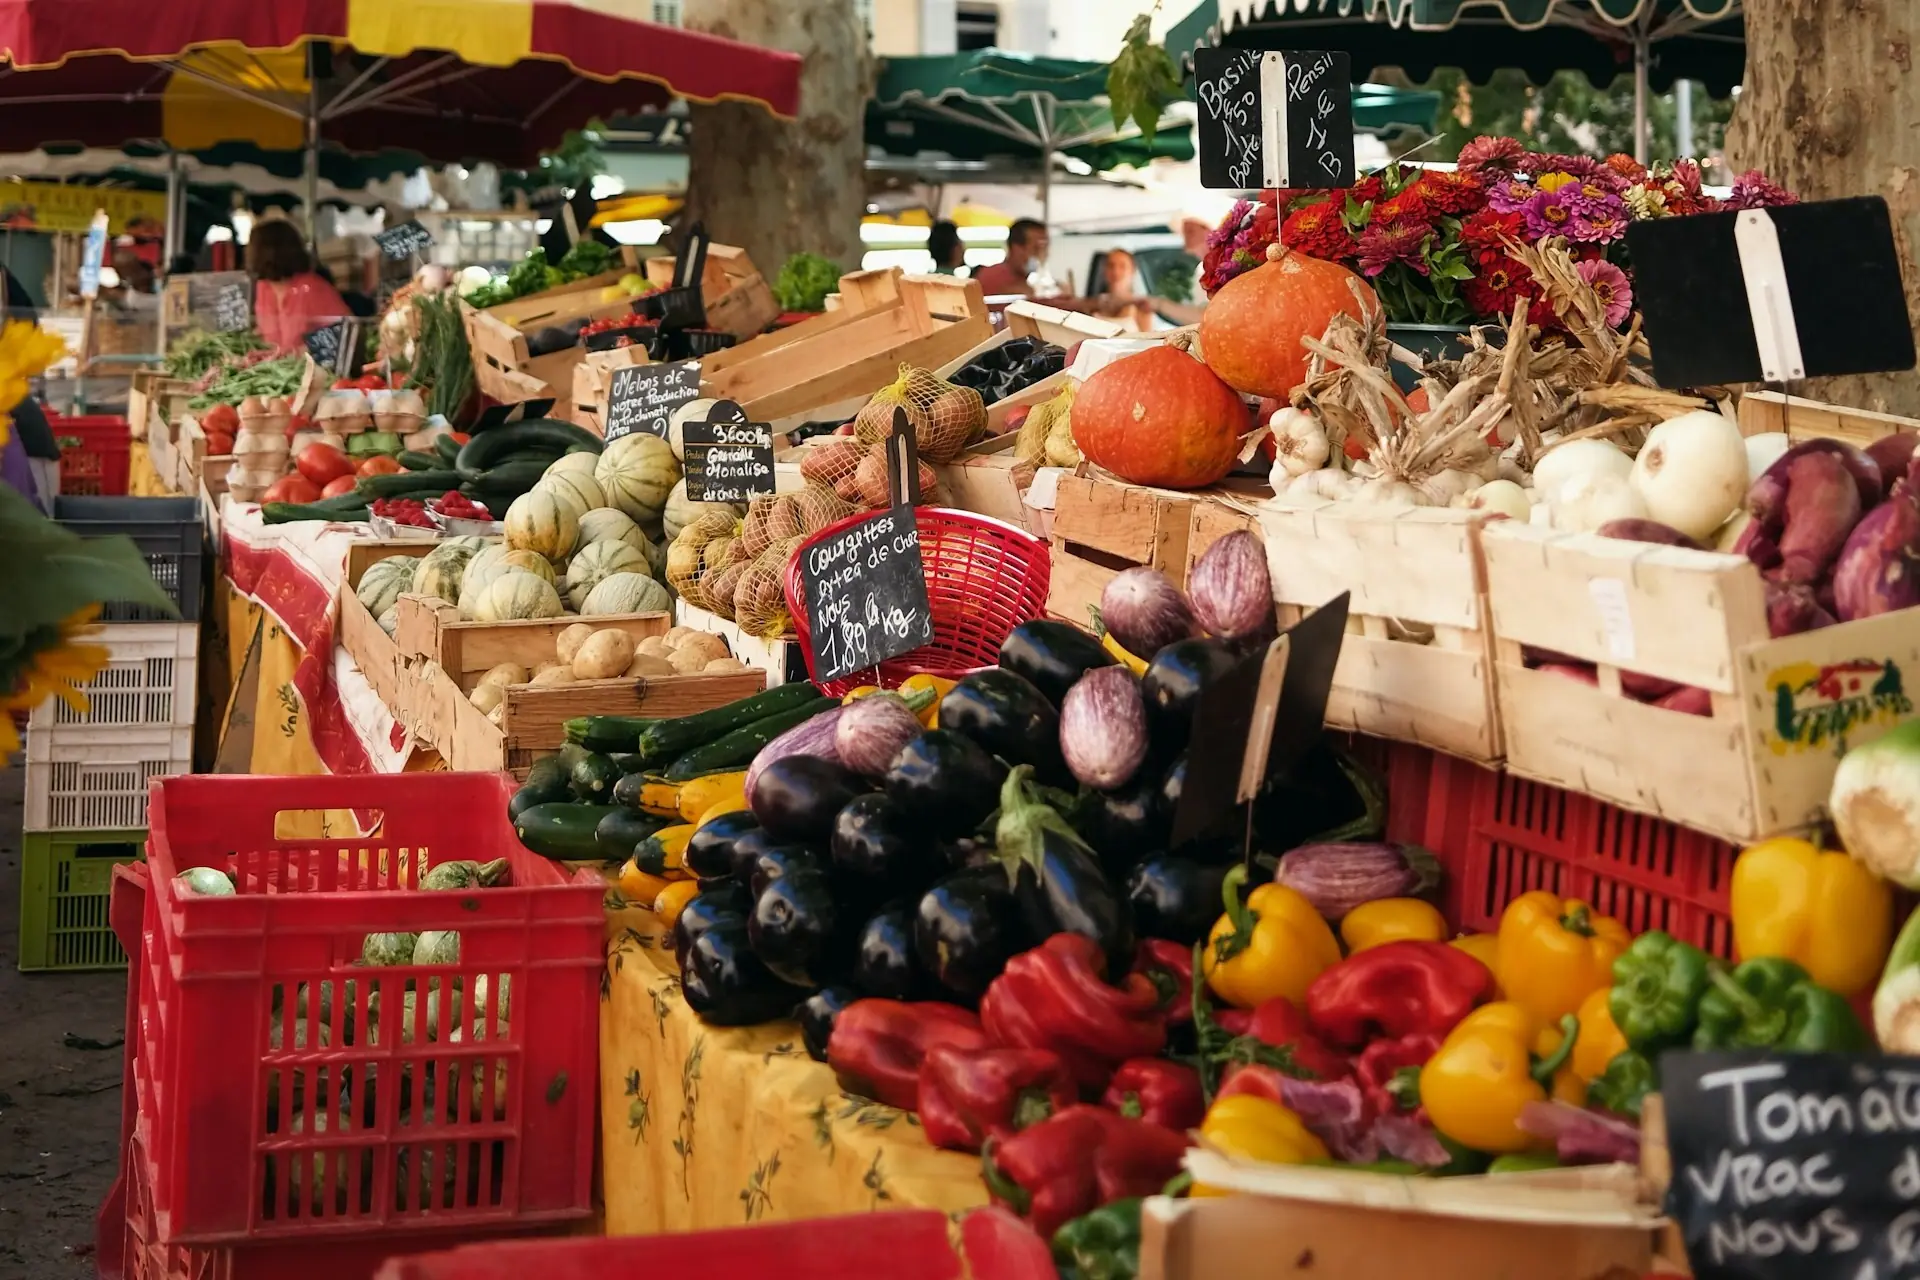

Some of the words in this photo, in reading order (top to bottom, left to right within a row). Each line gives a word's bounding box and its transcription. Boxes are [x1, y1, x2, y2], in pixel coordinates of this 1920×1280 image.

[613, 369, 660, 400] Melons
[705, 461, 770, 479] Monalisa
[808, 516, 895, 577] Courgettes
